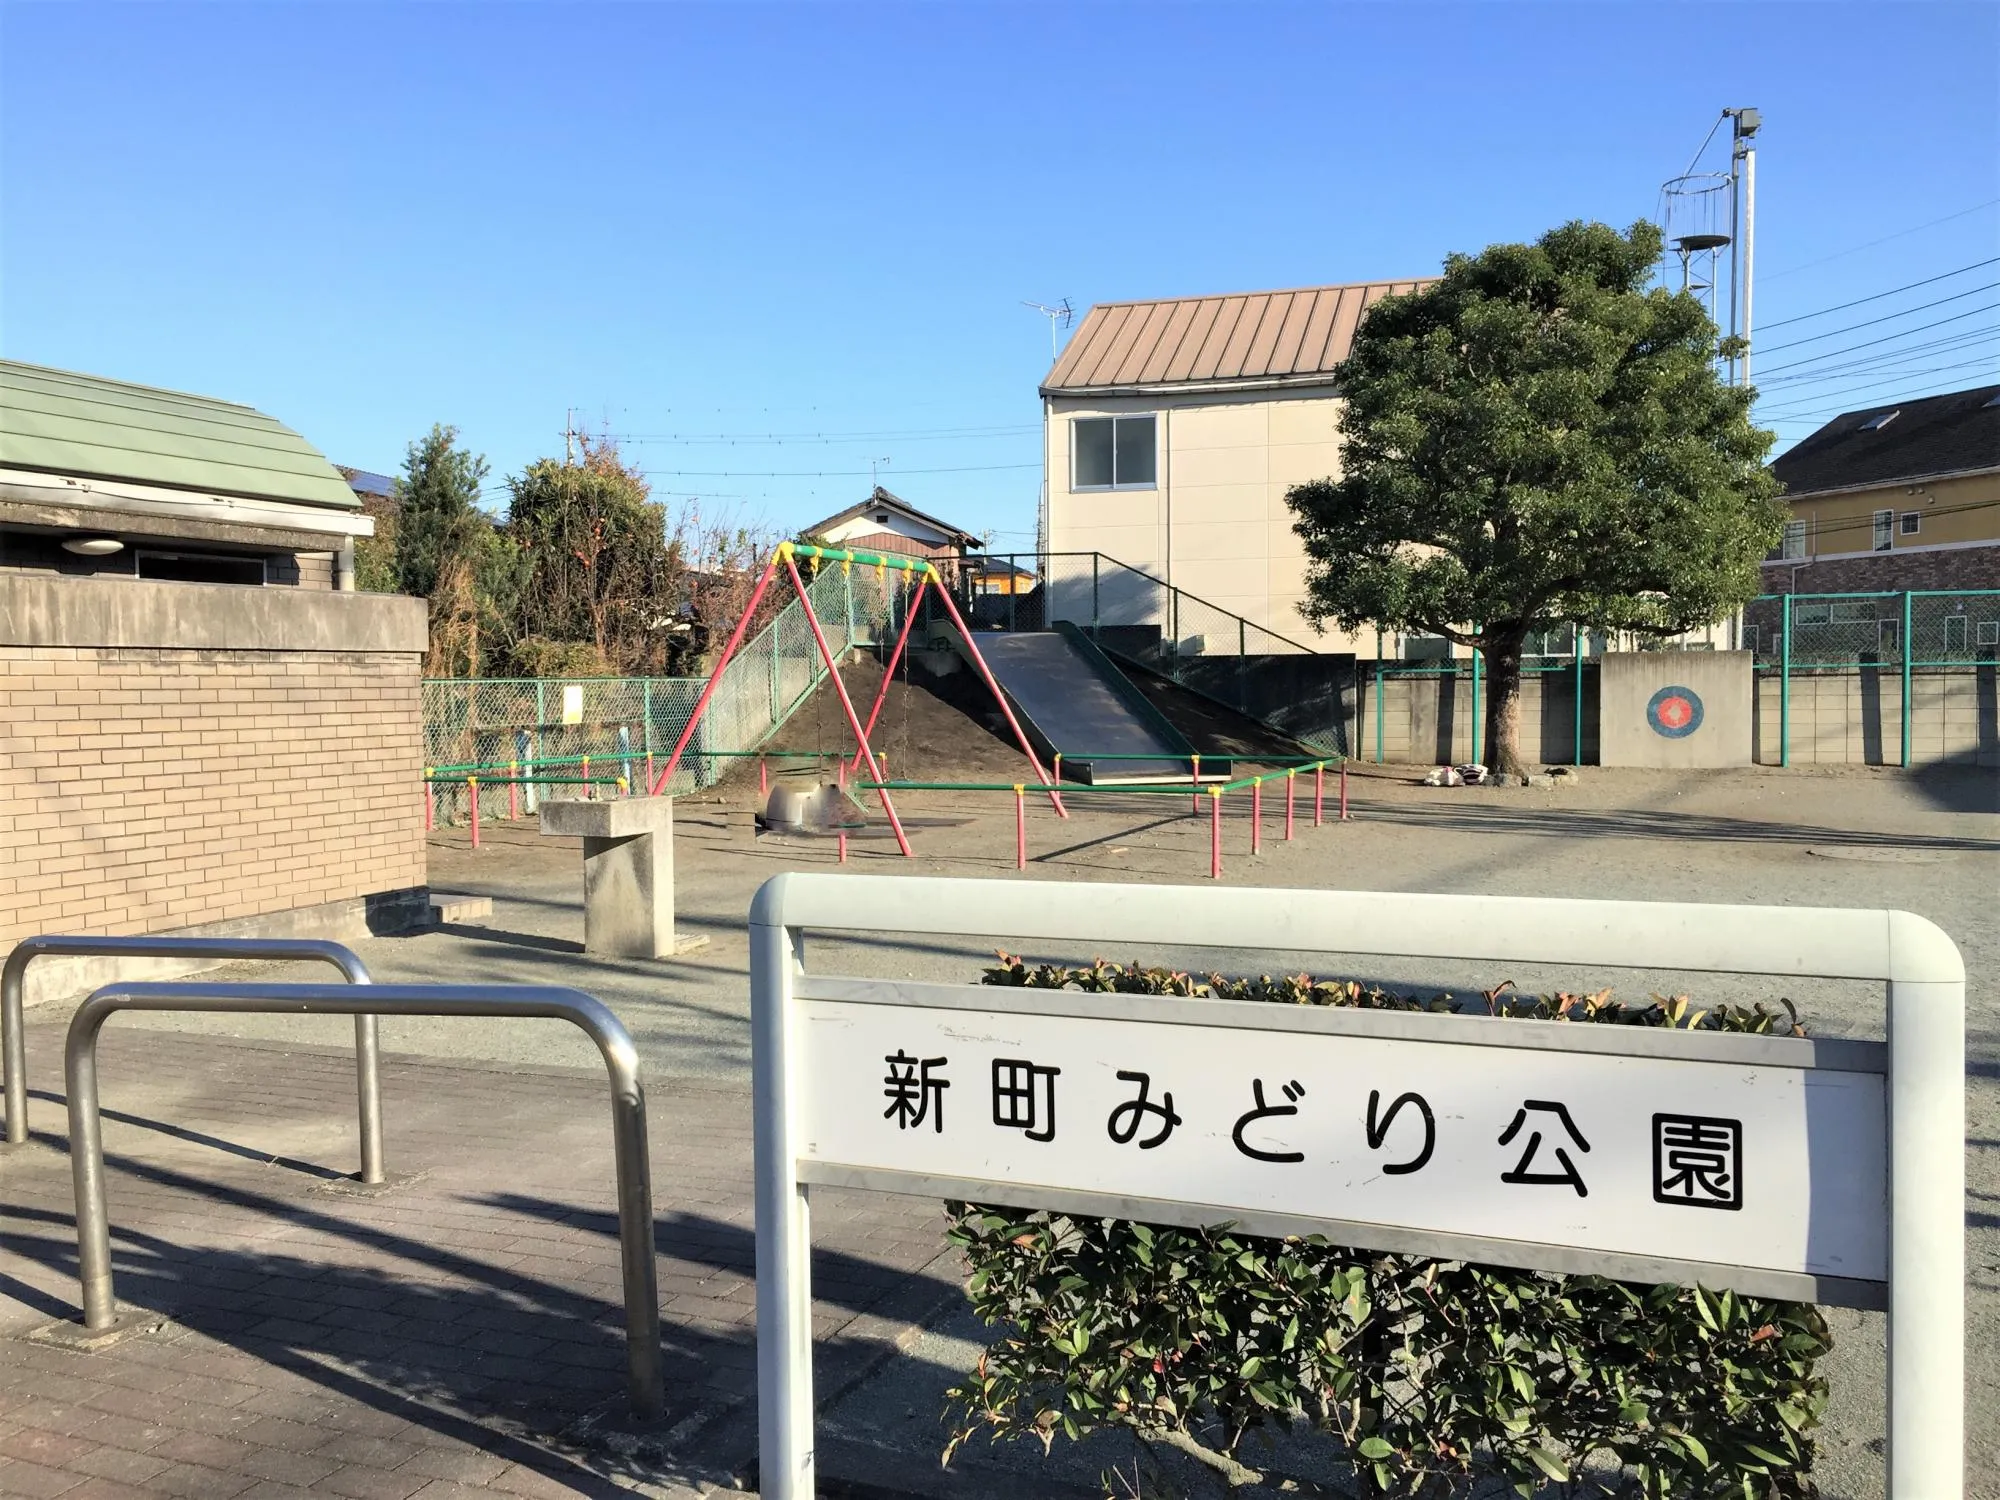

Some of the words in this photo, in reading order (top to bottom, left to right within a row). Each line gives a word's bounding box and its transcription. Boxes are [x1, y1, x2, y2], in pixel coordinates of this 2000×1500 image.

[883, 1048, 1743, 1211] 新町みどり公園
